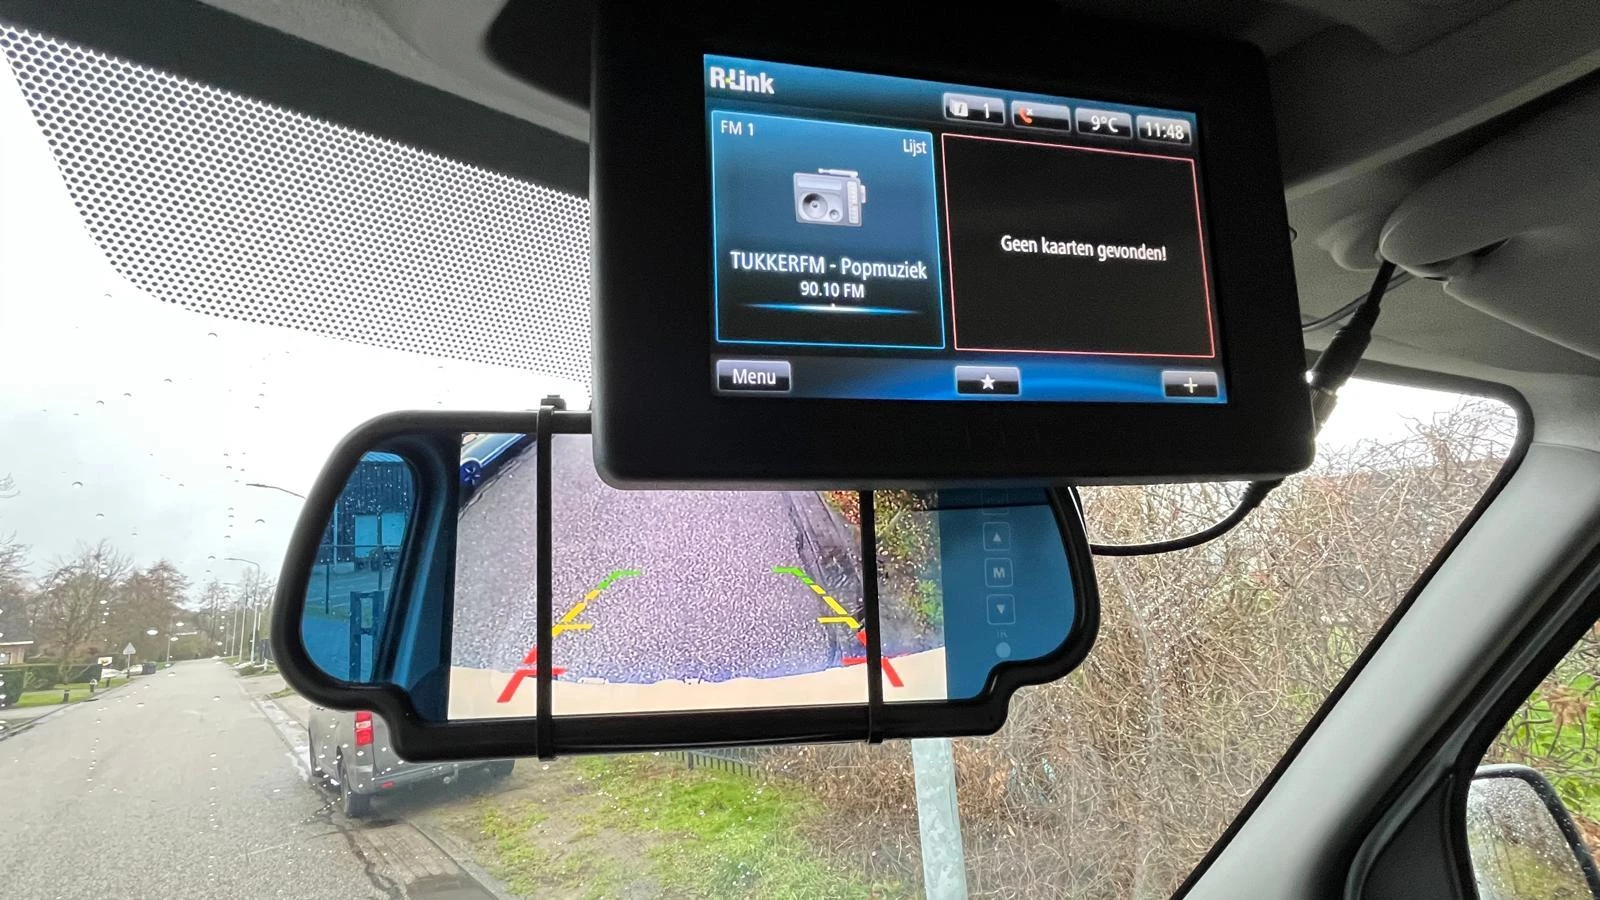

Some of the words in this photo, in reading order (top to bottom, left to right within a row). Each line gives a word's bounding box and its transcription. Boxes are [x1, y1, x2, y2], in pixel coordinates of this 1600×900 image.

[984, 103, 991, 119] 1
[720, 120, 742, 135] FM
[748, 122, 754, 136] 1
[1145, 121, 1185, 140] 11:48
[903, 138, 927, 157] Lijst
[1000, 235, 1038, 253] Geen
[1041, 236, 1094, 257] kaarten
[1097, 243, 1167, 262] gevonden!
[730, 251, 825, 274] TUKKERFM
[841, 257, 928, 281] Popmuziek
[800, 281, 840, 297] 90.10
[843, 284, 865, 299] FM
[732, 368, 777, 385] Menu
[993, 567, 1005, 578] M
